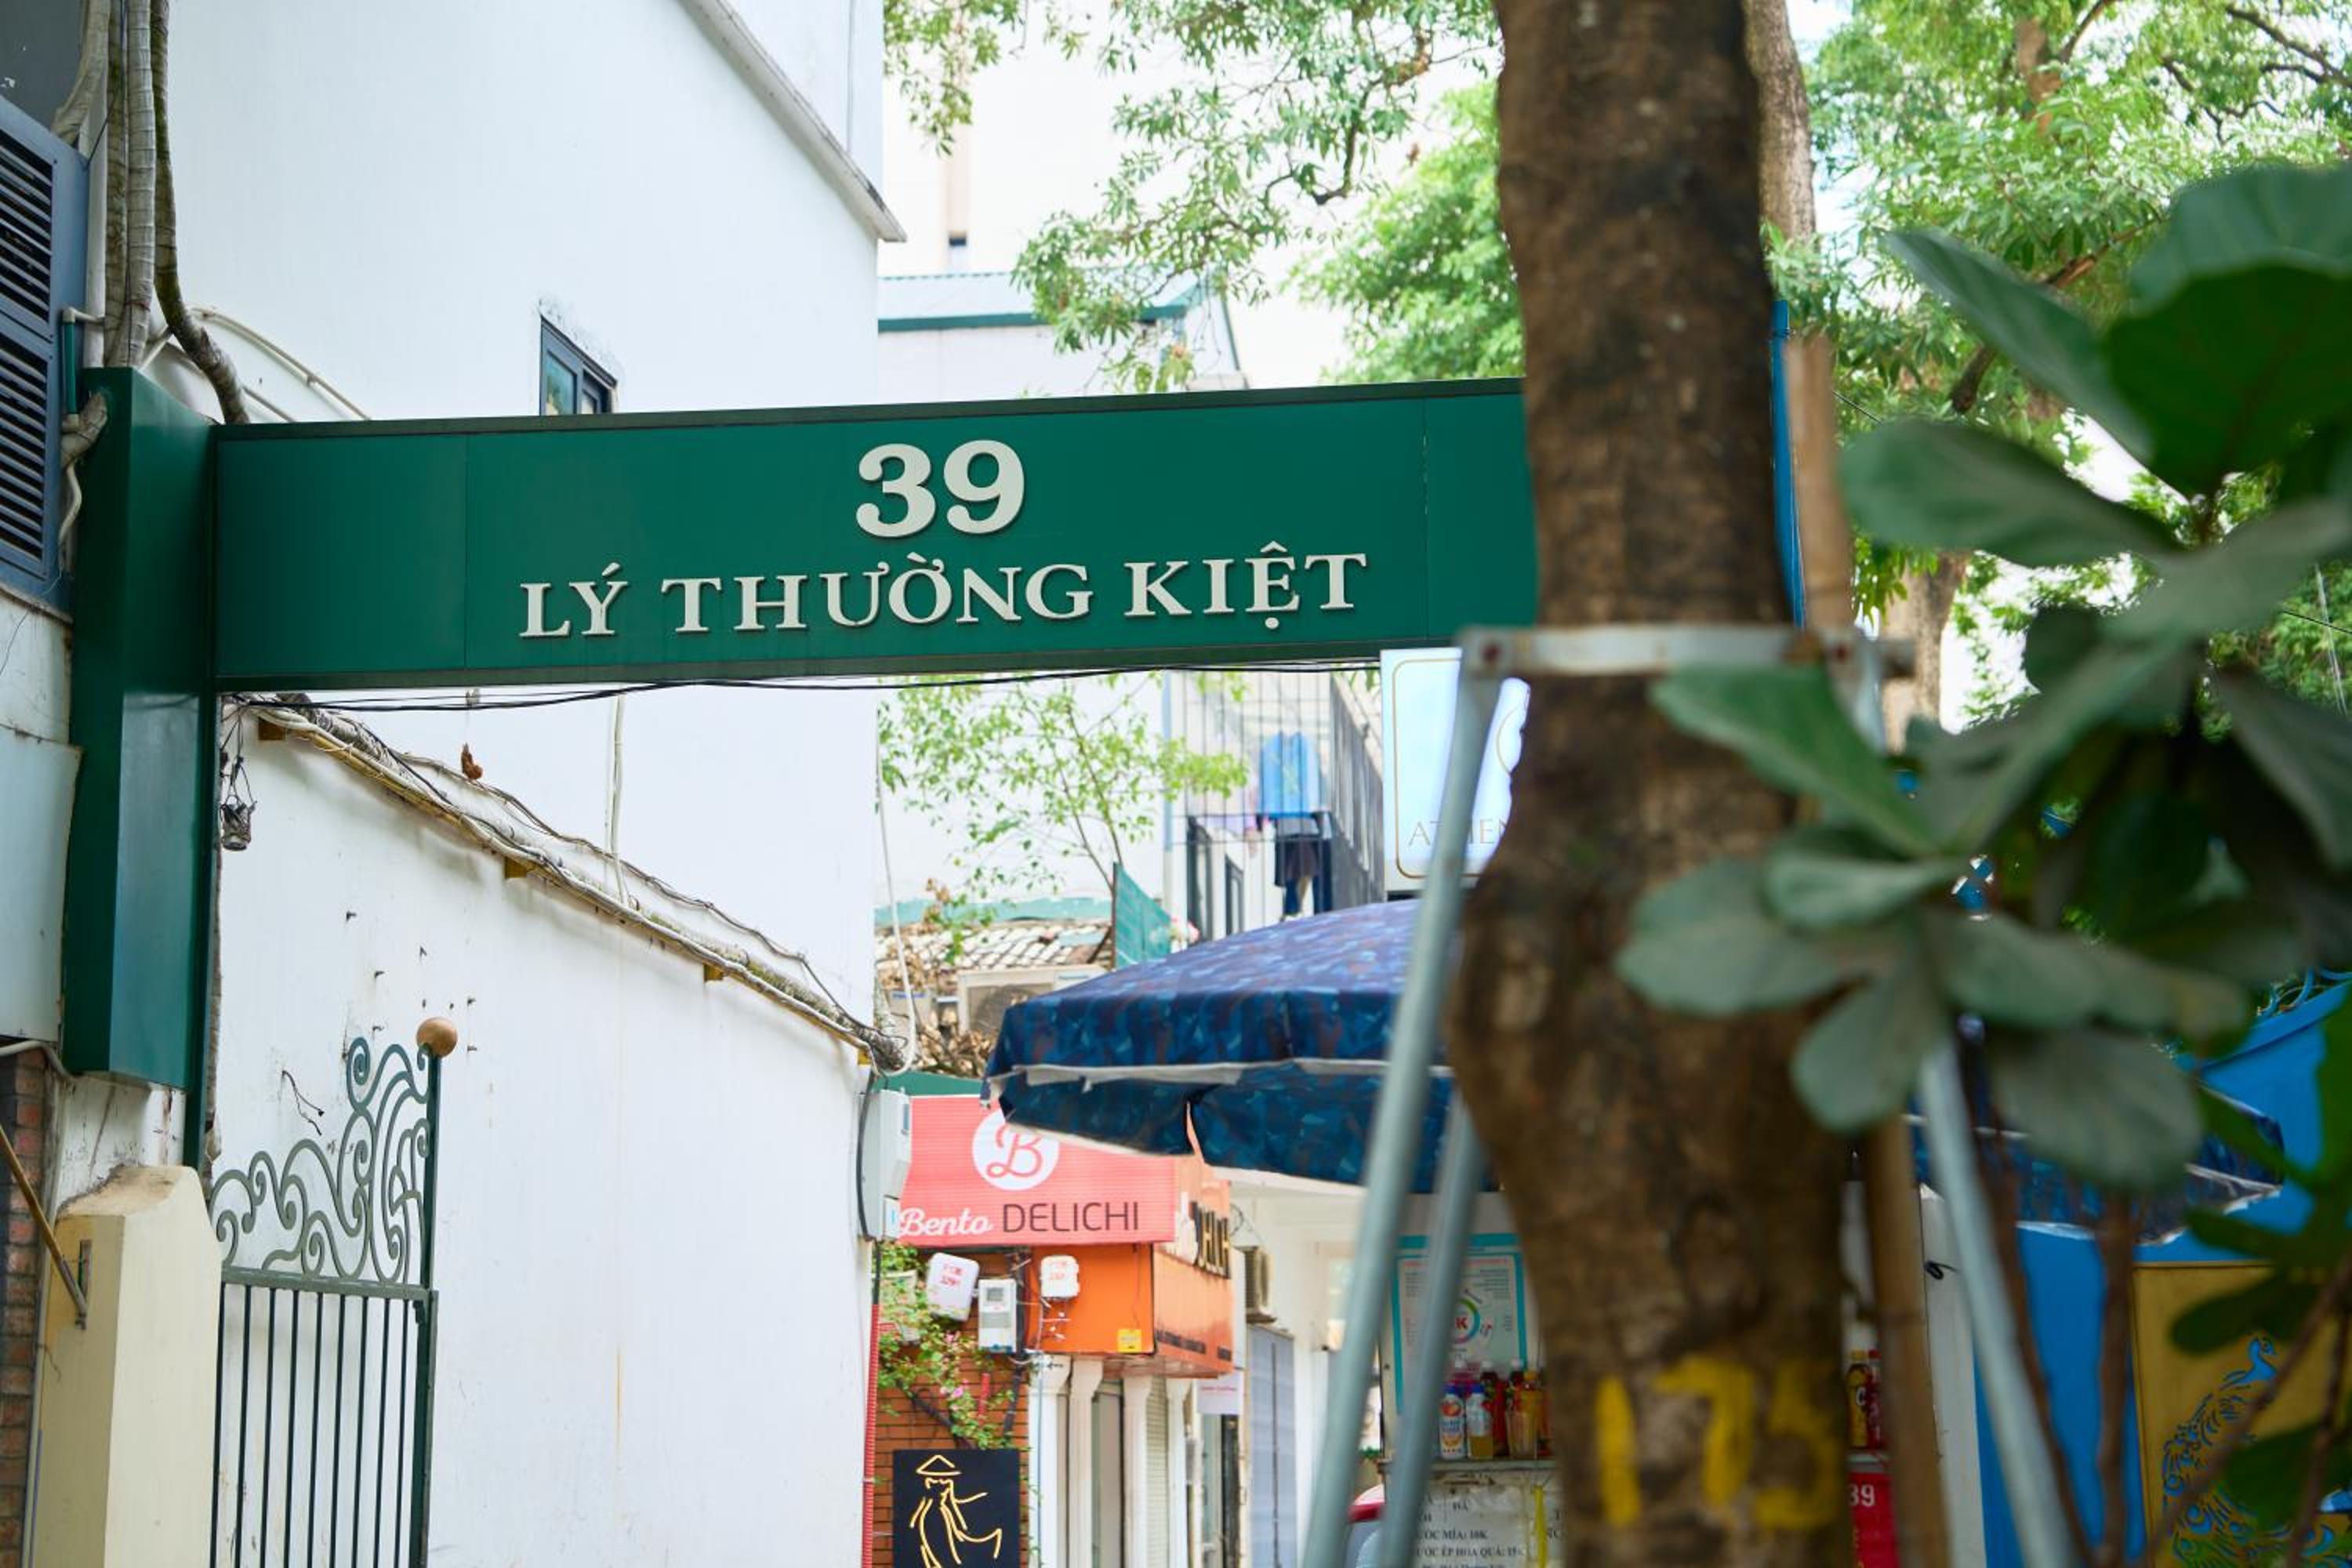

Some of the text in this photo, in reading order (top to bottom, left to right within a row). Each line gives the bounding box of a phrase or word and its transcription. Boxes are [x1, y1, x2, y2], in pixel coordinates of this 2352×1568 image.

[856, 440, 1025, 538] 39
[519, 541, 1367, 638] LÝ THƯỜNG KIỆT
[898, 1201, 1138, 1236] Bento DELICHI
